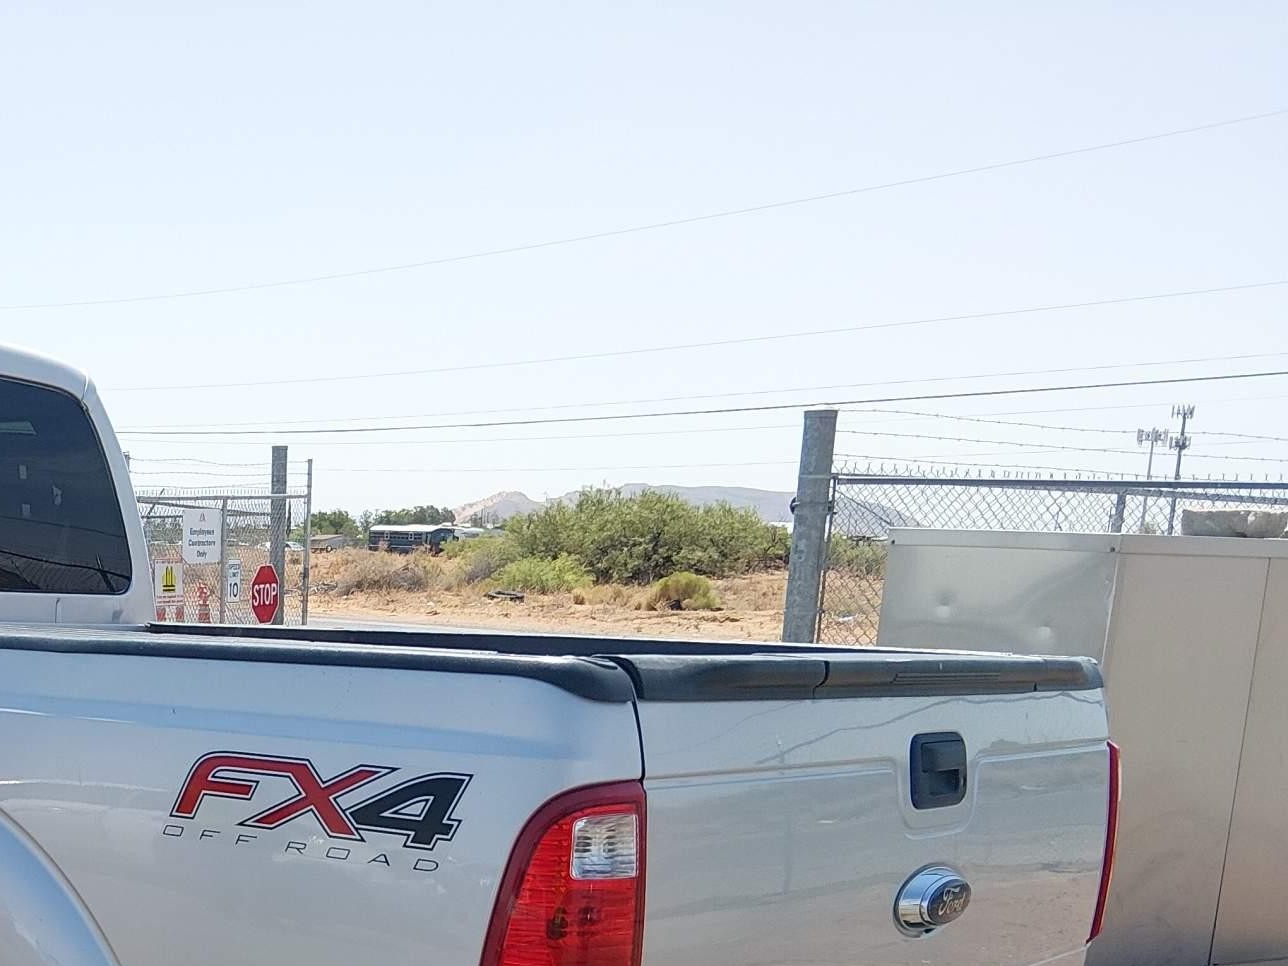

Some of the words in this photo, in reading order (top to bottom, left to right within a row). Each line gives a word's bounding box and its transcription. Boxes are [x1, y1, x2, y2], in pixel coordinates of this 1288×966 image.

[229, 582, 239, 598] 10
[253, 583, 277, 606] STOP
[169, 751, 474, 850] FX4
[163, 825, 258, 846] OFF
[285, 841, 440, 872] ROAD
[938, 886, 966, 916] Ford
